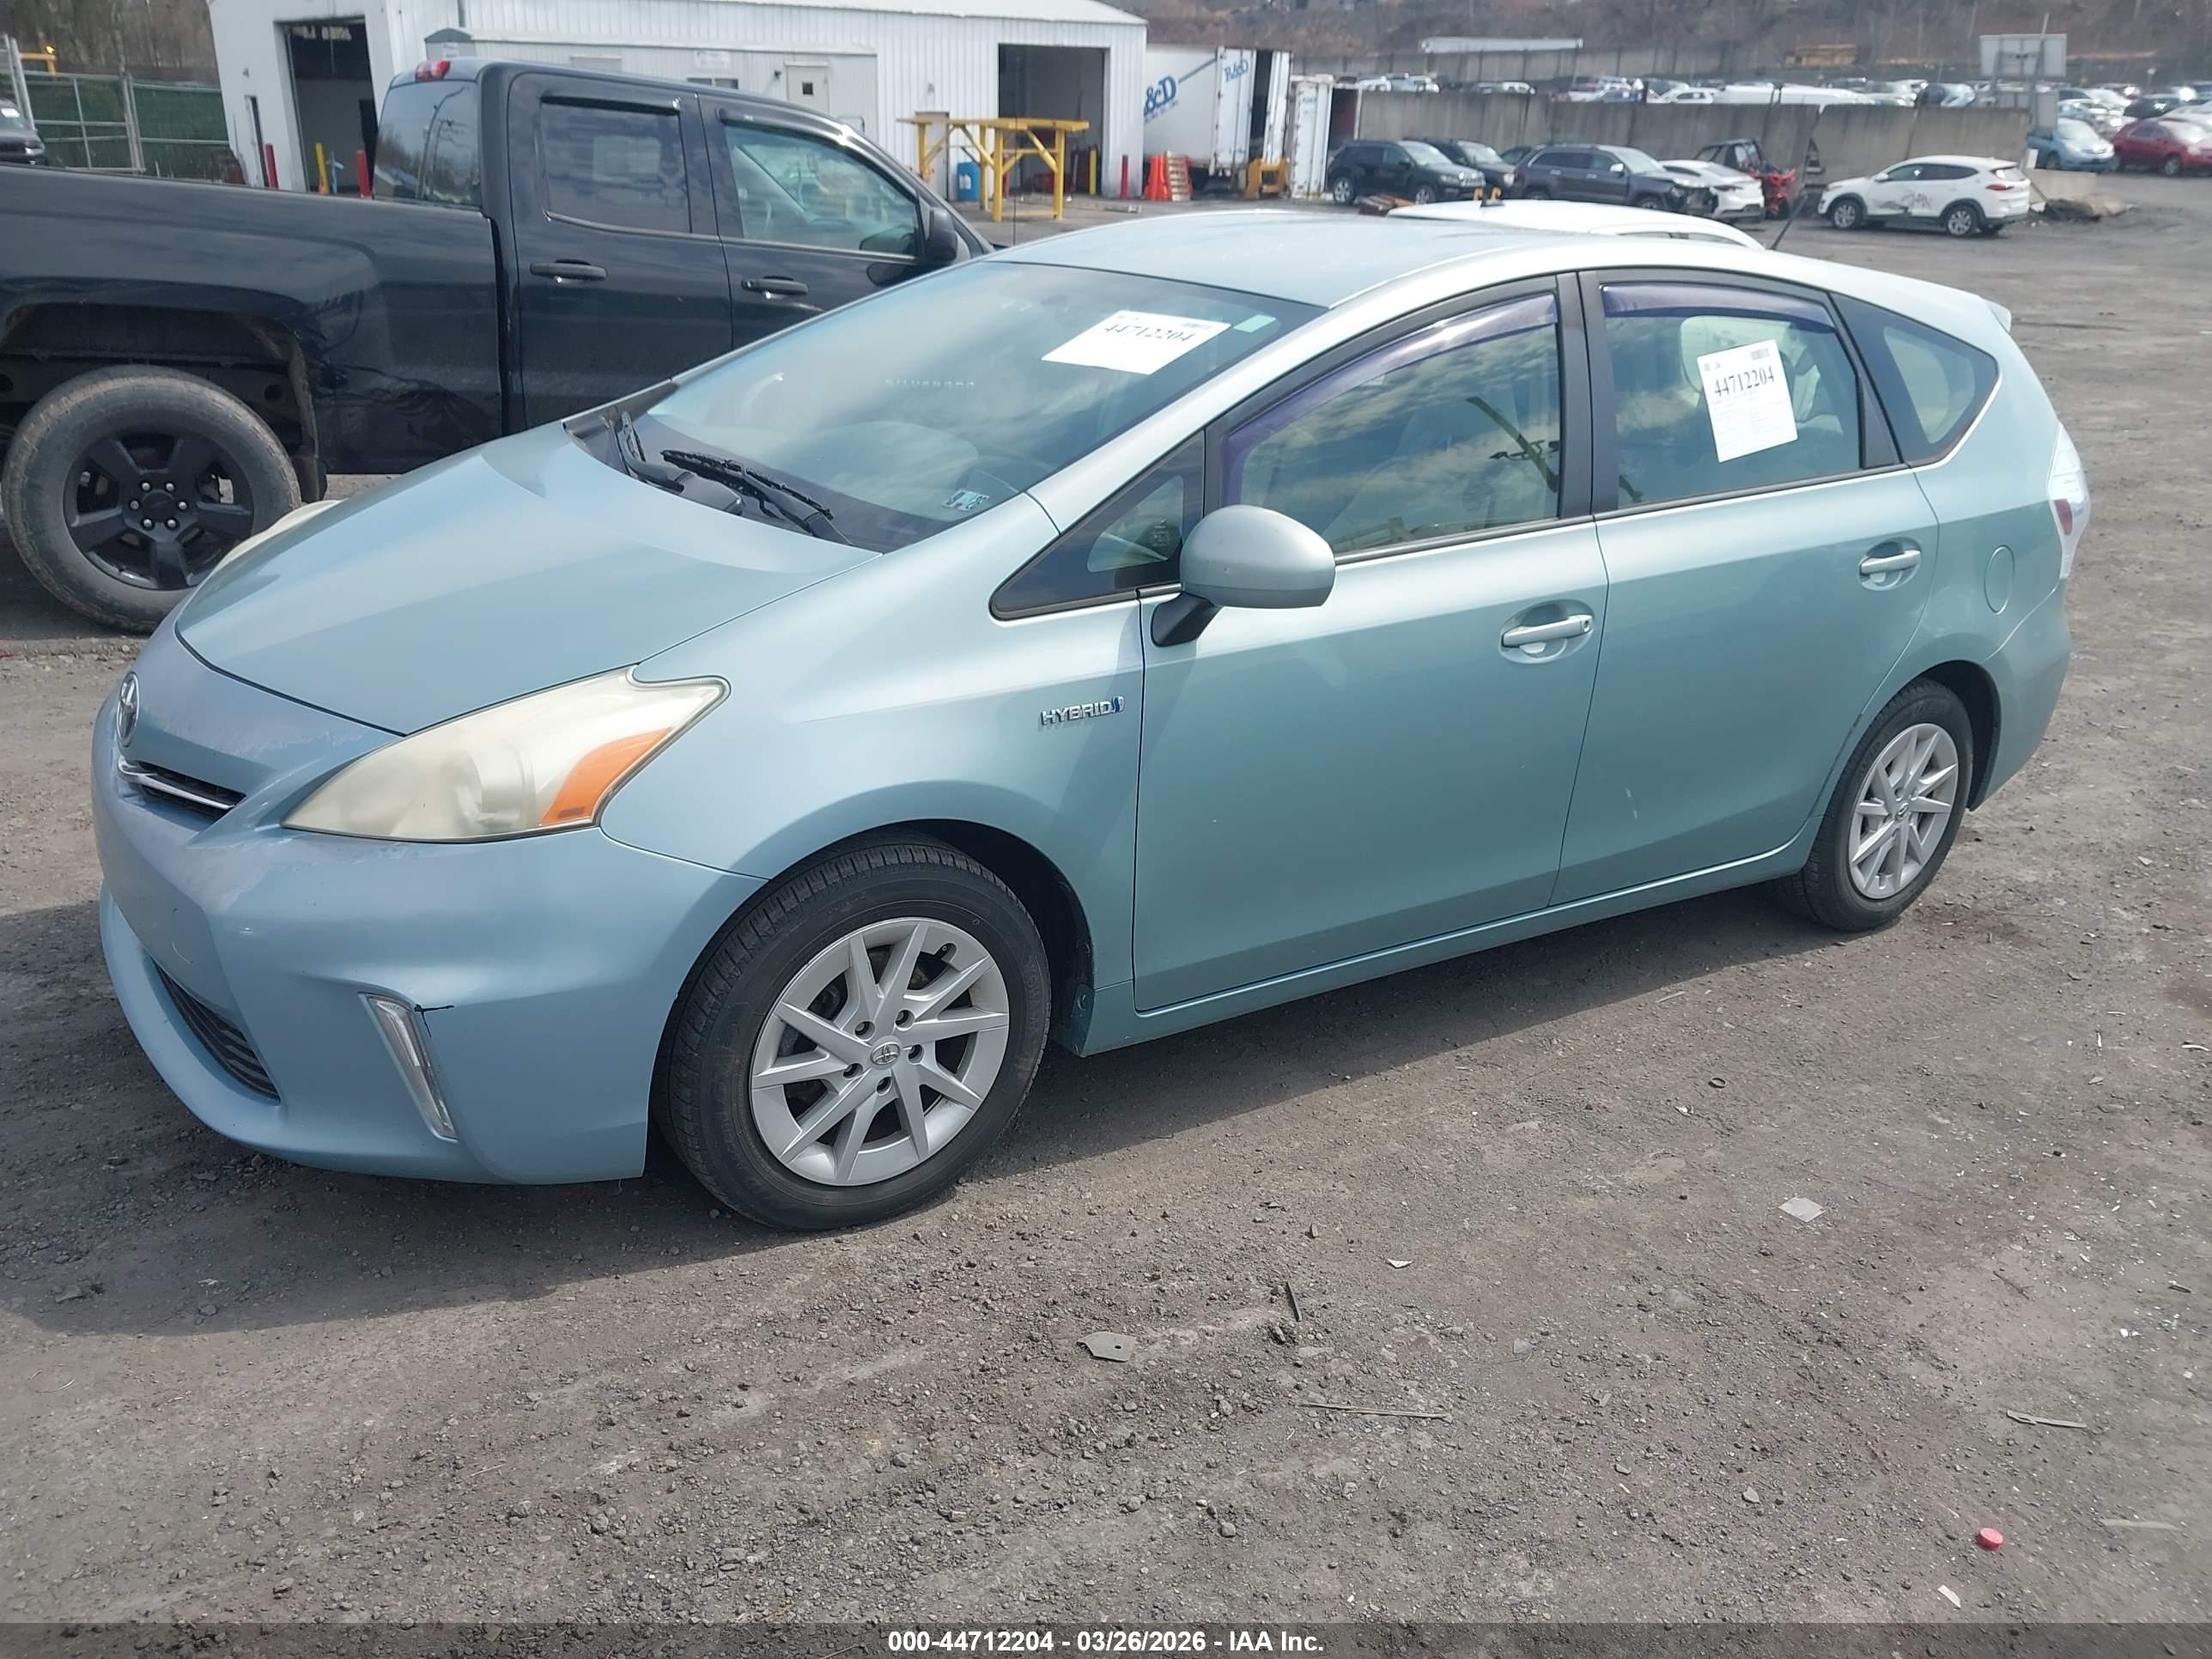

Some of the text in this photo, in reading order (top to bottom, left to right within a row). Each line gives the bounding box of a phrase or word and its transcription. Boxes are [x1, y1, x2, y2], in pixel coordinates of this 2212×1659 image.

[1104, 324, 1195, 342] 44712204
[1714, 365, 1775, 397] 44712204
[1040, 700, 1113, 726] HYBRID
